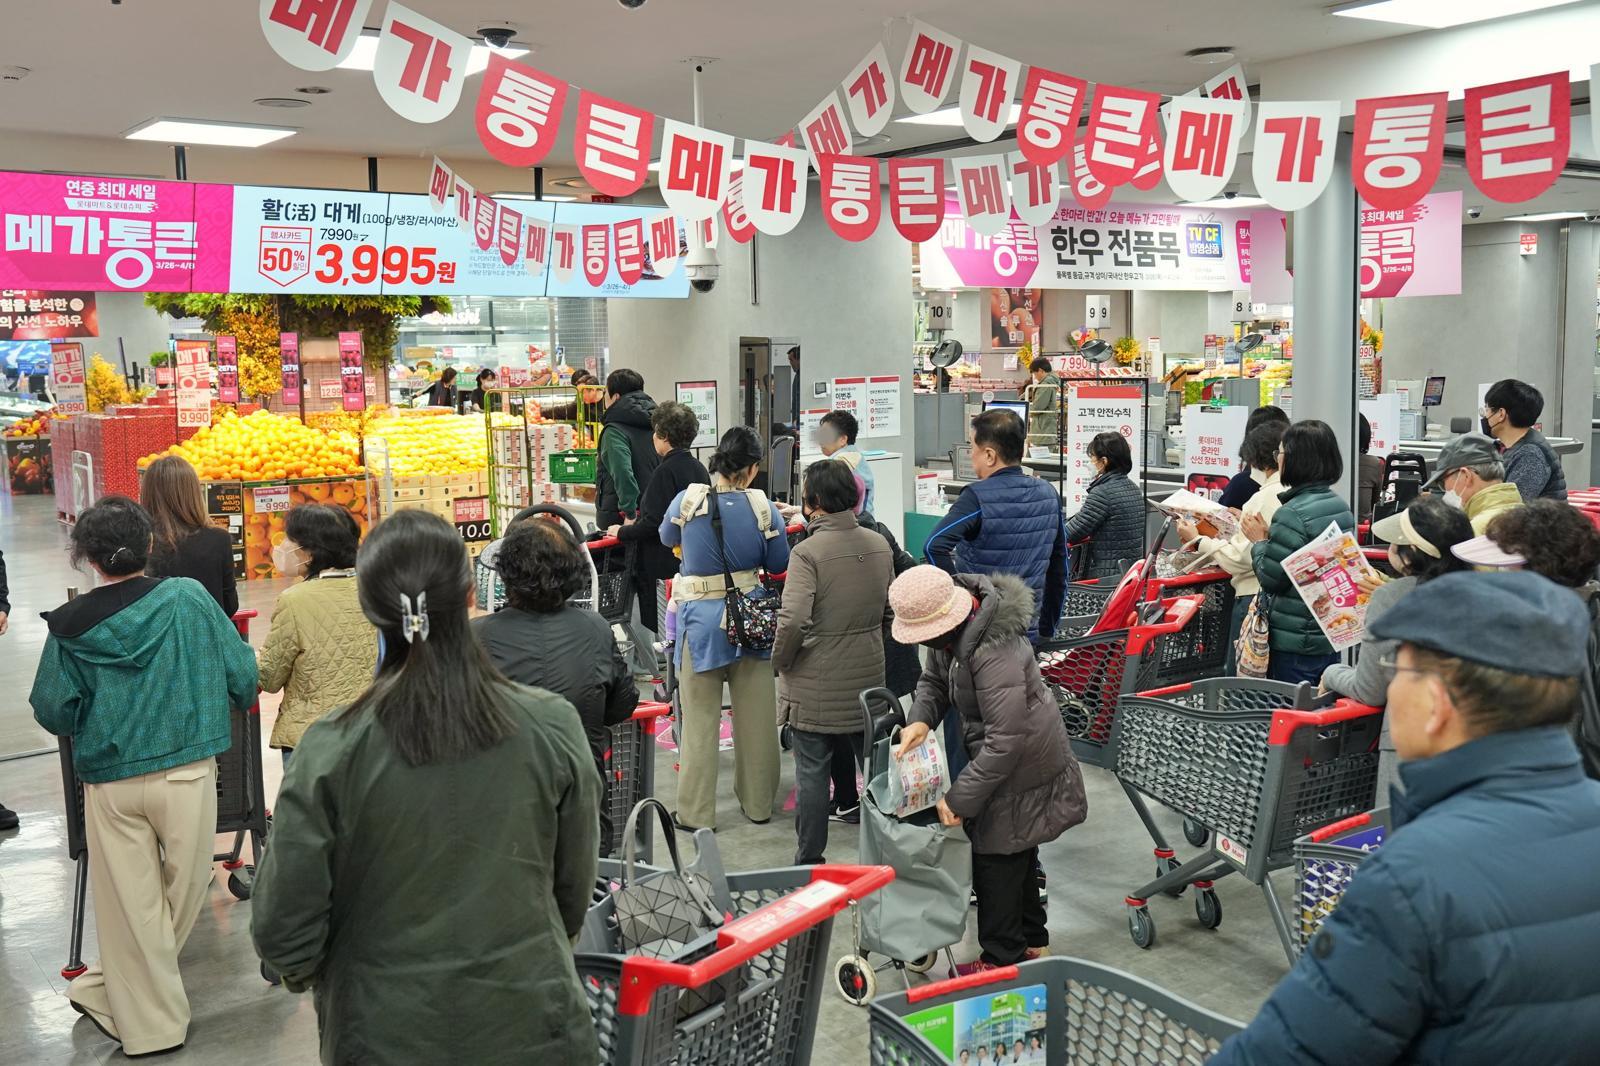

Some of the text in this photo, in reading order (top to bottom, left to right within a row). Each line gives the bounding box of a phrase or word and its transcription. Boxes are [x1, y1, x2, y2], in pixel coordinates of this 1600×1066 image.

[389, 20, 454, 103] 가
[904, 33, 953, 99] 메
[486, 69, 556, 149] 통
[849, 61, 888, 119] 가
[969, 59, 1007, 123] 가
[806, 104, 848, 155] 메
[1024, 79, 1078, 148] 통
[1091, 96, 1149, 169] 큰
[1479, 84, 1555, 180] 큰
[583, 104, 642, 181] 큰
[1172, 110, 1233, 177] 메
[1264, 116, 1324, 183] 가
[1363, 104, 1435, 188] 통
[431, 163, 450, 205] 메
[667, 133, 724, 201] 메
[749, 154, 797, 213] 가
[1013, 162, 1053, 207] 가
[66, 180, 156, 200] 연중 최대 세일
[262, 198, 316, 223] 활(活)
[324, 202, 361, 224] 대게
[456, 184, 470, 221] 가
[831, 163, 871, 224] 통
[899, 165, 938, 224] 큰
[961, 165, 1006, 217] 메
[476, 200, 496, 241] 통
[500, 213, 519, 256] 큰
[1189, 227, 1218, 242] TV CF
[1367, 211, 1384, 223] 최대
[1385, 208, 1404, 221] 세일
[5, 213, 198, 288] 메가통큰
[526, 224, 546, 263] 메
[554, 232, 574, 269] 가
[586, 230, 606, 274] 통
[617, 225, 639, 272] 큰
[651, 216, 676, 262] 메
[1050, 225, 1181, 268] 한우 전품목
[15, 315, 42, 328] 신선
[45, 315, 83, 328] 노하우
[29, 298, 68, 312] 분석한
[930, 306, 943, 318] 10
[1089, 307, 1096, 319] 9
[1101, 307, 1107, 319] 9
[1236, 302, 1242, 312] 8
[1078, 407, 1132, 418] 고객 안전수칙
[1075, 443, 1082, 453] 2
[1075, 460, 1082, 470] 3
[1075, 478, 1082, 488] 4
[1075, 495, 1082, 505] 5
[459, 523, 491, 538] 10,0
